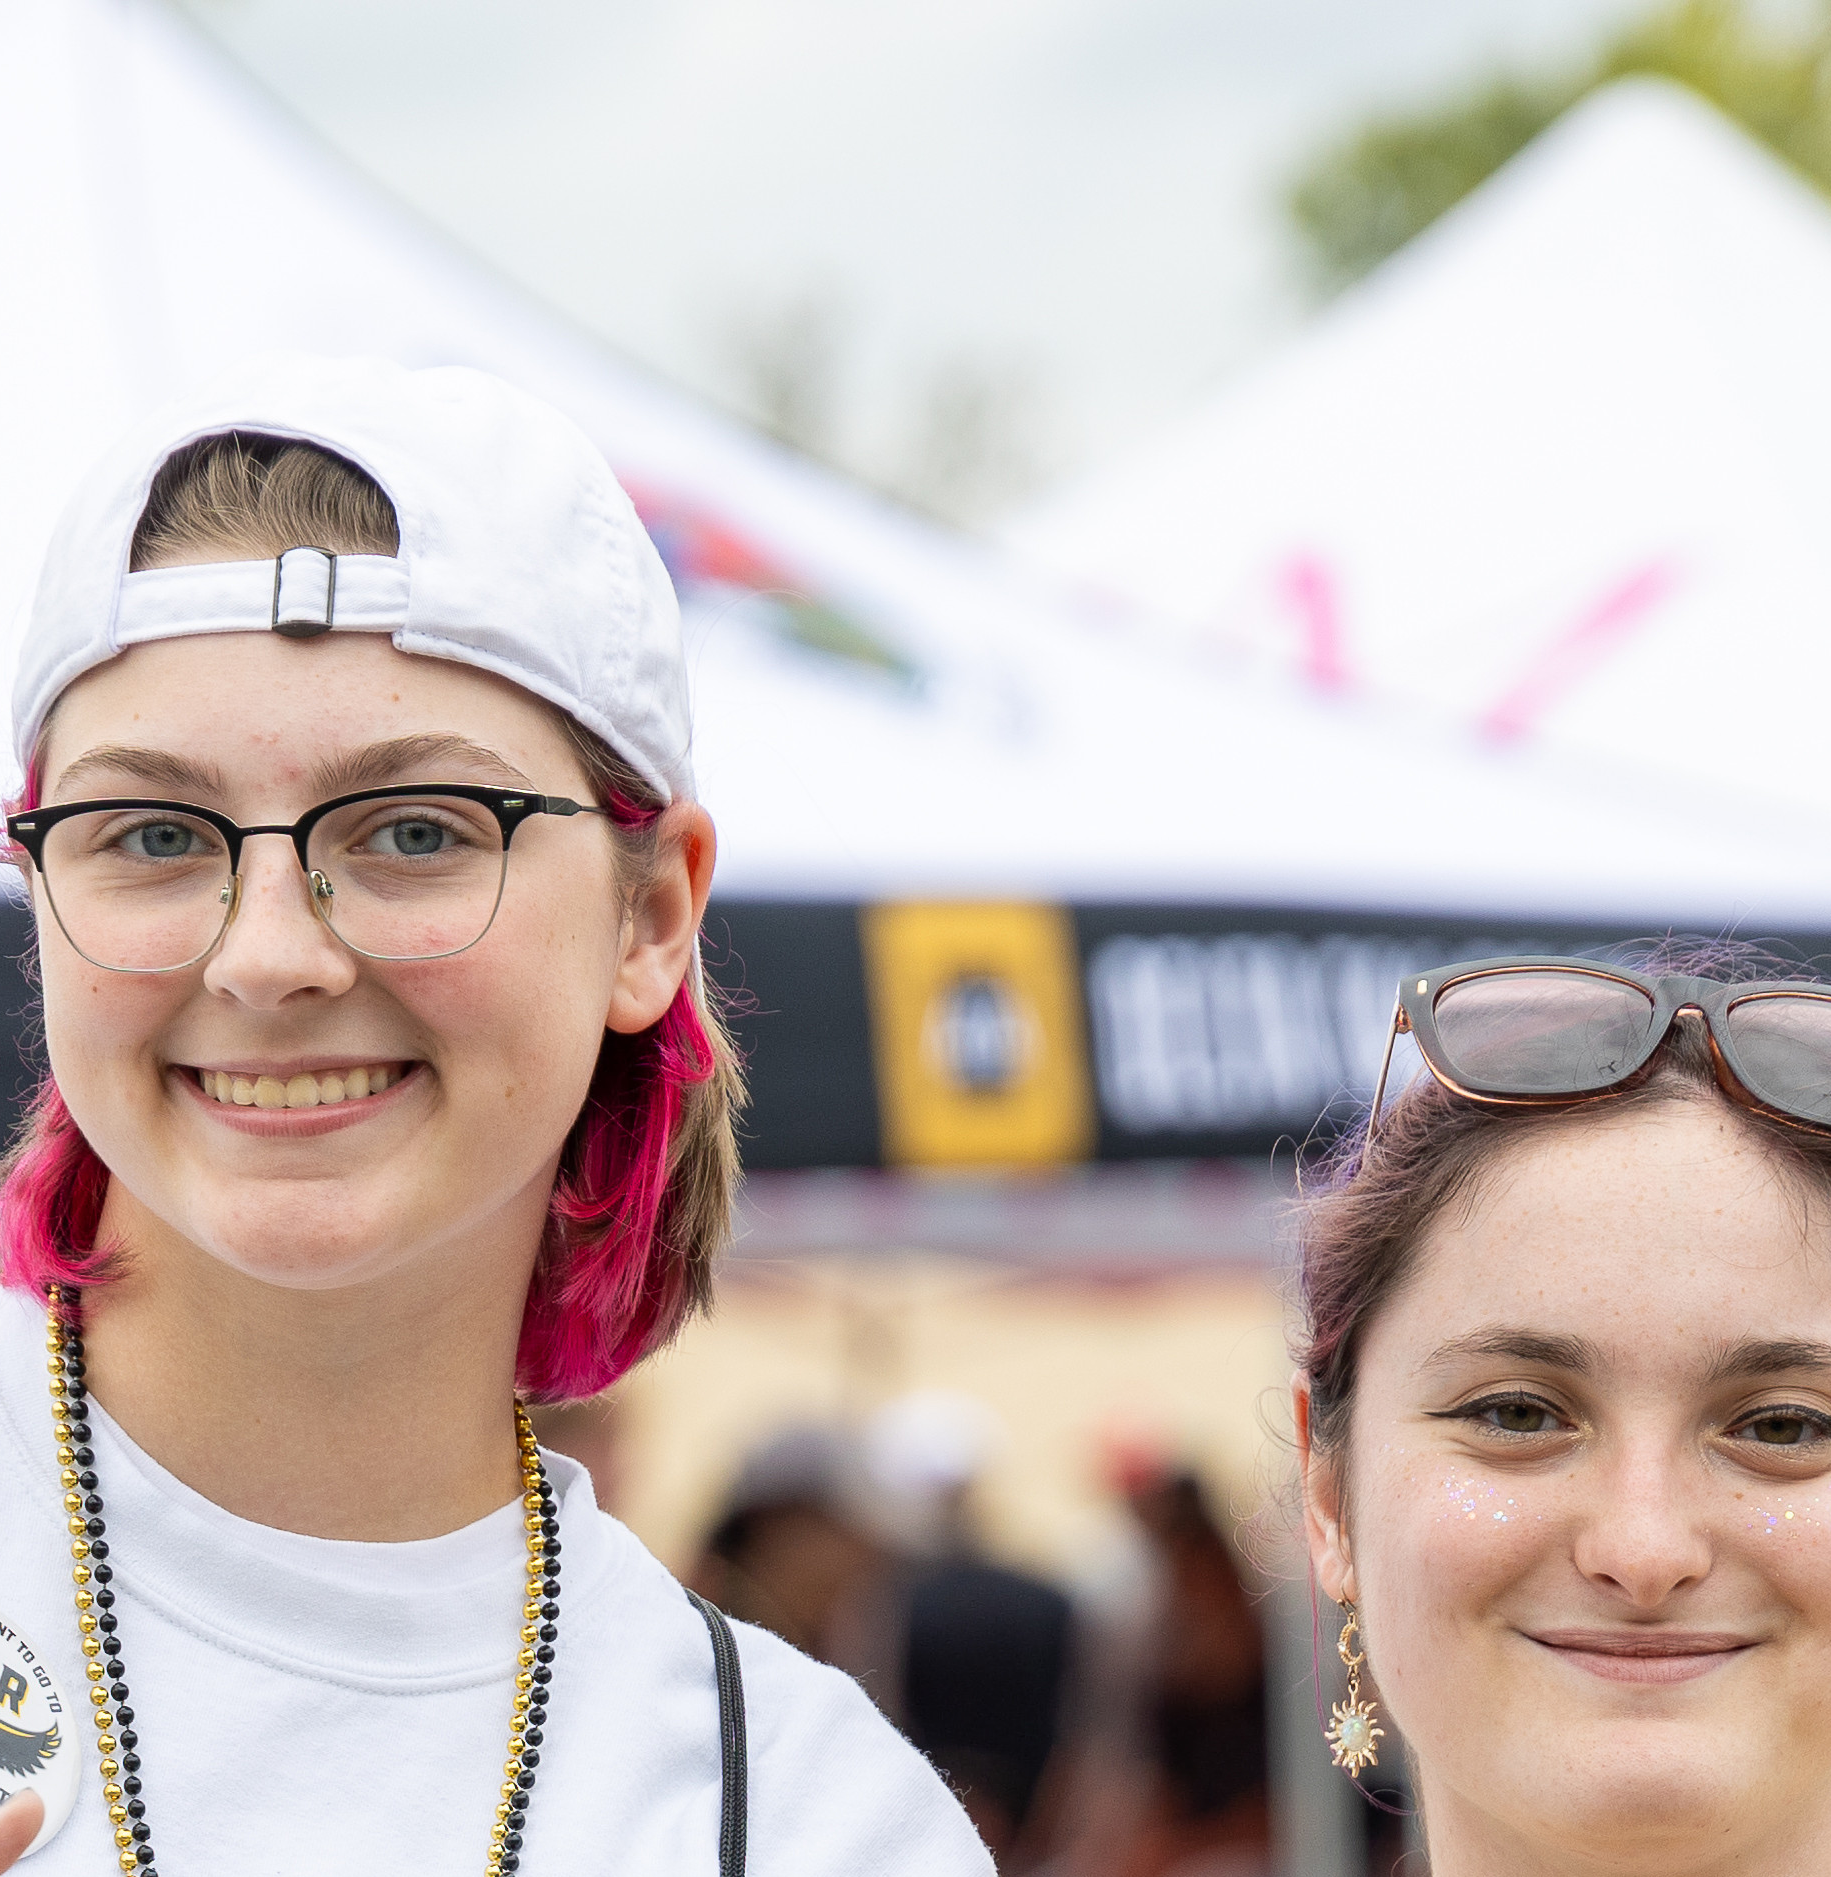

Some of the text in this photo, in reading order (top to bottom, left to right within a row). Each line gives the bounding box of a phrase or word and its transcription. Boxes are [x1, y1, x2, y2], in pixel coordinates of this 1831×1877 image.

[16, 1641, 35, 1664] TO
[32, 1665, 52, 1688] GO
[46, 1692, 63, 1713] TO
